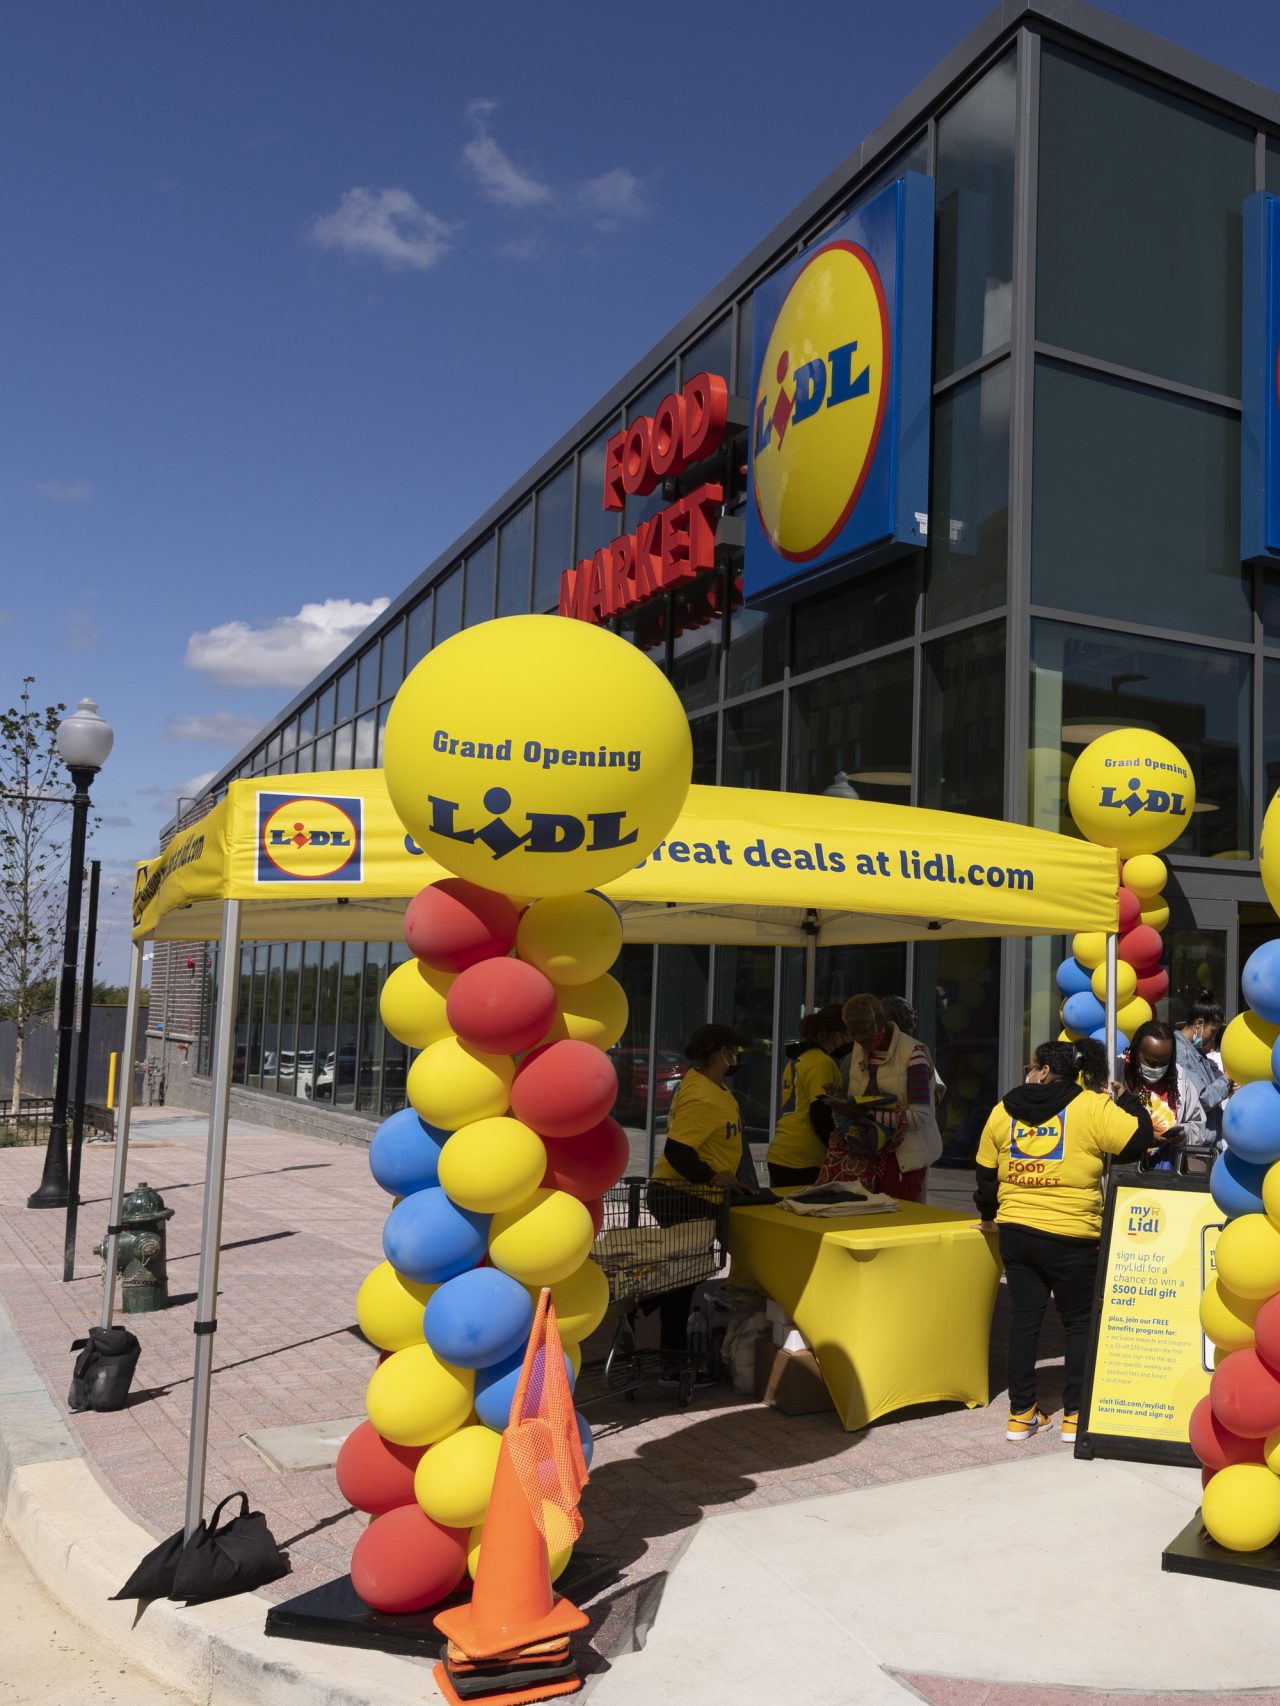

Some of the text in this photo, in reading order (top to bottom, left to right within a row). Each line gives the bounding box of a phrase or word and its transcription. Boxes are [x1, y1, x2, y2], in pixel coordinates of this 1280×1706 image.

[604, 371, 728, 511] FOOD
[559, 483, 724, 624] MARKET
[433, 730, 641, 772] Grand Opening
[1104, 758, 1187, 778] Grand Opening
[634, 838, 1034, 891] reat deals at lidl.com
[1008, 1161, 1045, 1174] FOOD
[1007, 1175, 1060, 1186] MARKET
[1130, 1206, 1150, 1217] my
[1128, 1217, 1159, 1233] Lidl
[1117, 1251, 1165, 1263] sign up for
[1115, 1263, 1145, 1272] myLidl
[1148, 1264, 1160, 1274] for
[1114, 1273, 1146, 1284] chance
[1149, 1277, 1158, 1285] to
[1160, 1278, 1176, 1286] win
[1112, 1284, 1177, 1299] $500 Lidl gift
[1111, 1298, 1135, 1306] card!
[1108, 1315, 1124, 1323] plus,
[1126, 1316, 1139, 1324] join
